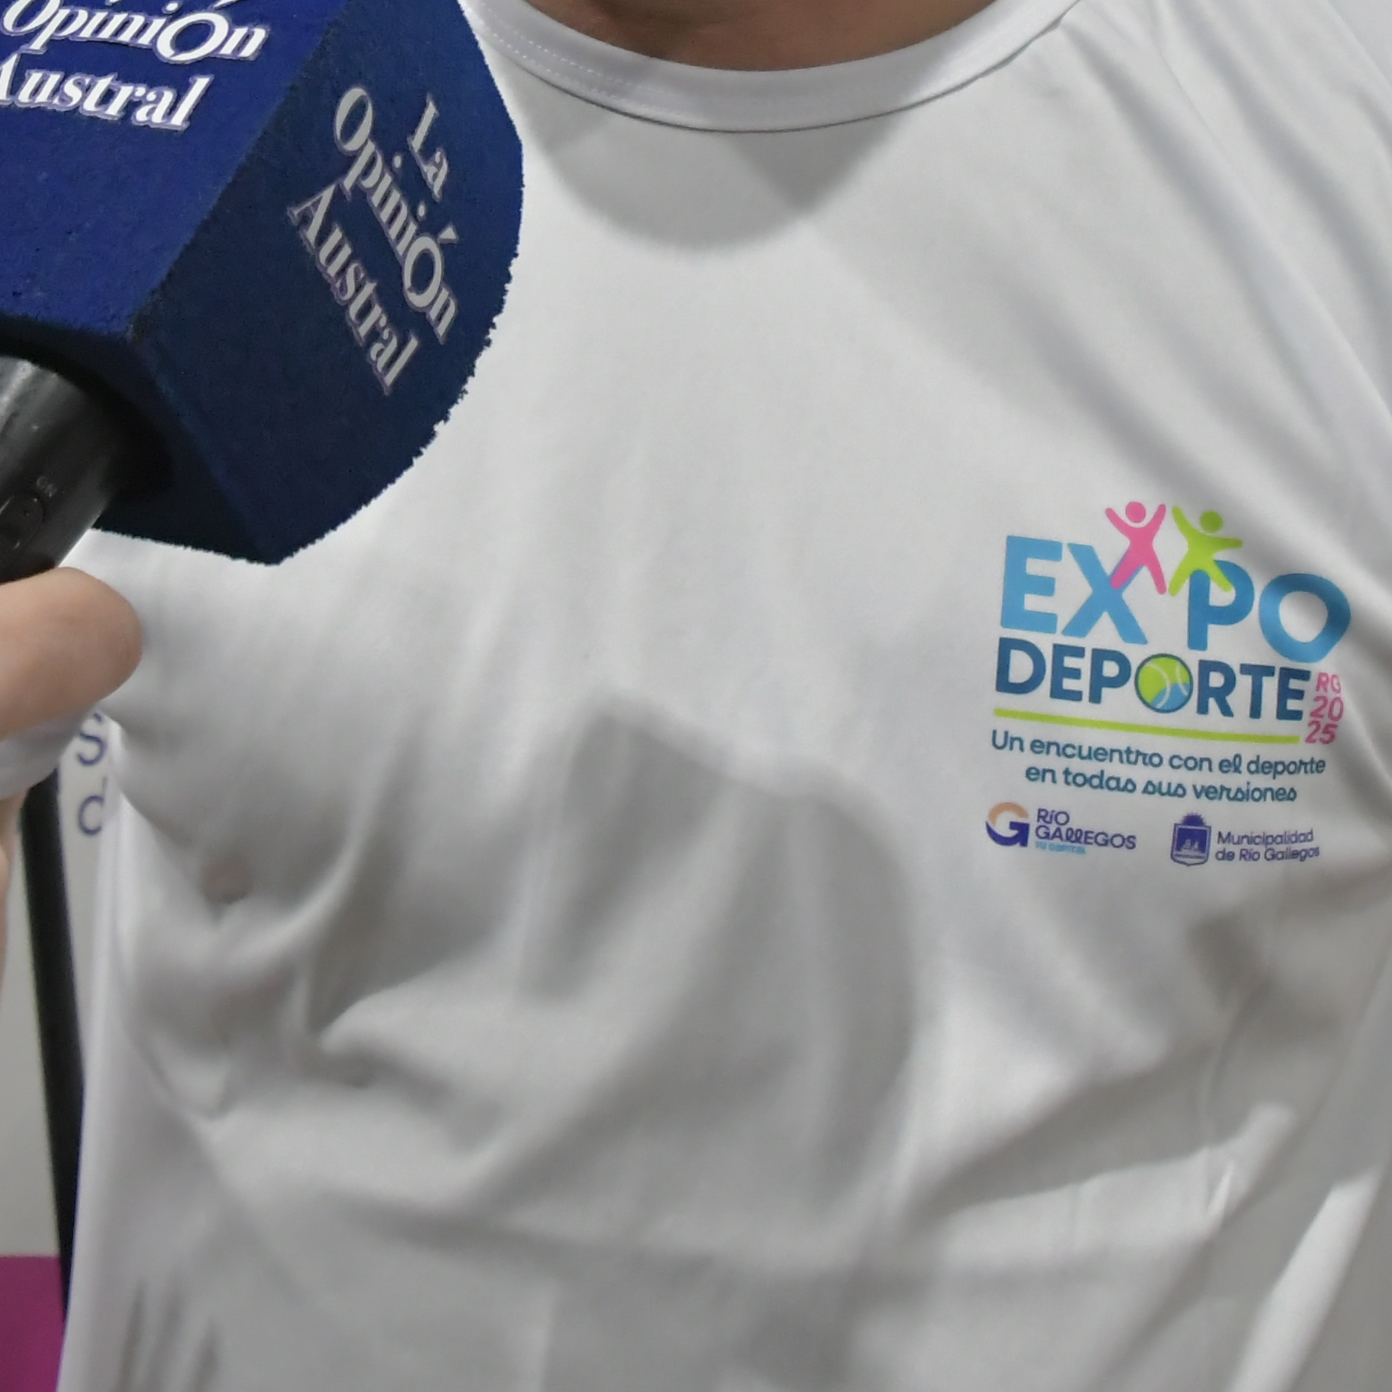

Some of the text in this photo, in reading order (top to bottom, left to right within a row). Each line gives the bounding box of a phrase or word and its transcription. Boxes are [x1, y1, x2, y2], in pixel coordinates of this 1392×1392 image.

[409, 94, 451, 202] La
[287, 182, 419, 395] Austral
[1000, 534, 1351, 664] EXPO
[995, 637, 1311, 721] DEPORTE
[1316, 672, 1342, 694] RG
[1310, 695, 1344, 722] 20
[1305, 720, 1338, 745] 25
[991, 729, 1327, 779] Un encuentro con el deporte
[1025, 765, 1298, 803] en todas sus versiones
[1215, 848, 1236, 861] de
[1264, 846, 1321, 862] Gallegos
[1217, 829, 1314, 847] Municipalidad
